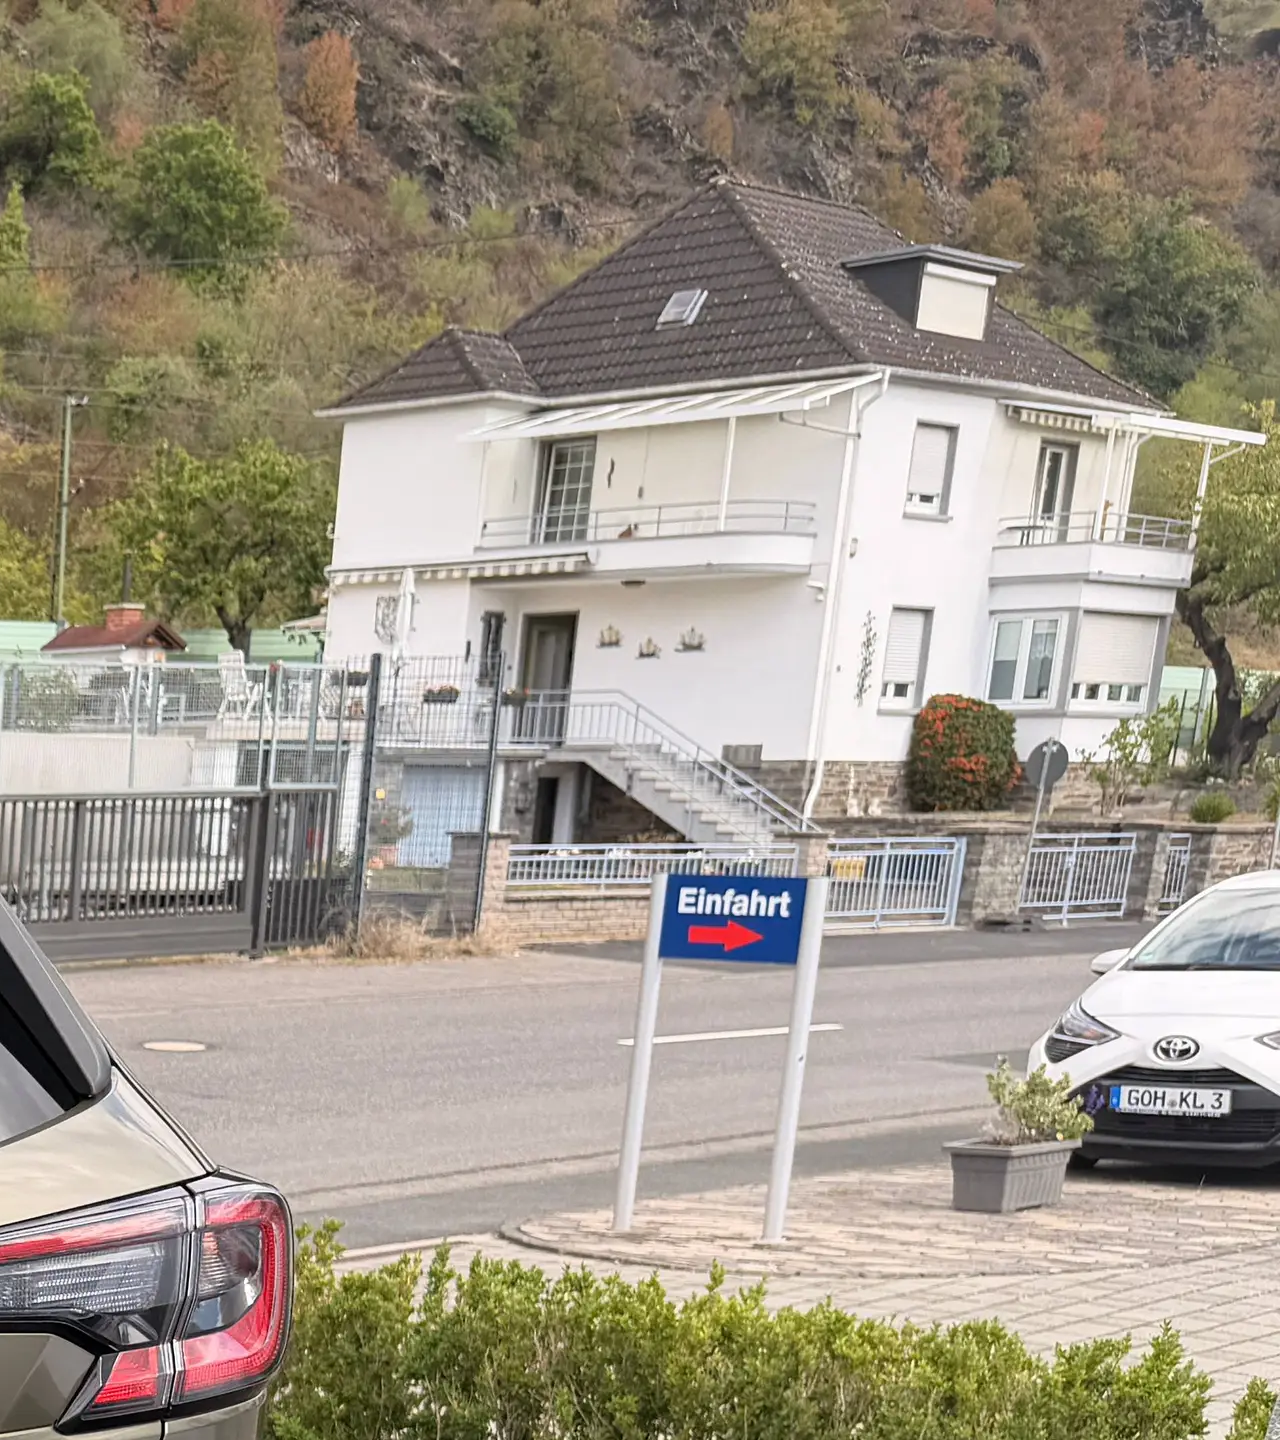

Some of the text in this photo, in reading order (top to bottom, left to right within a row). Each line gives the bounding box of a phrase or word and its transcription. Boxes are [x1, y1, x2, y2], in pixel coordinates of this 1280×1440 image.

[677, 887, 792, 918] Einfahrt
[1128, 1089, 1223, 1109] GOH KL 3
